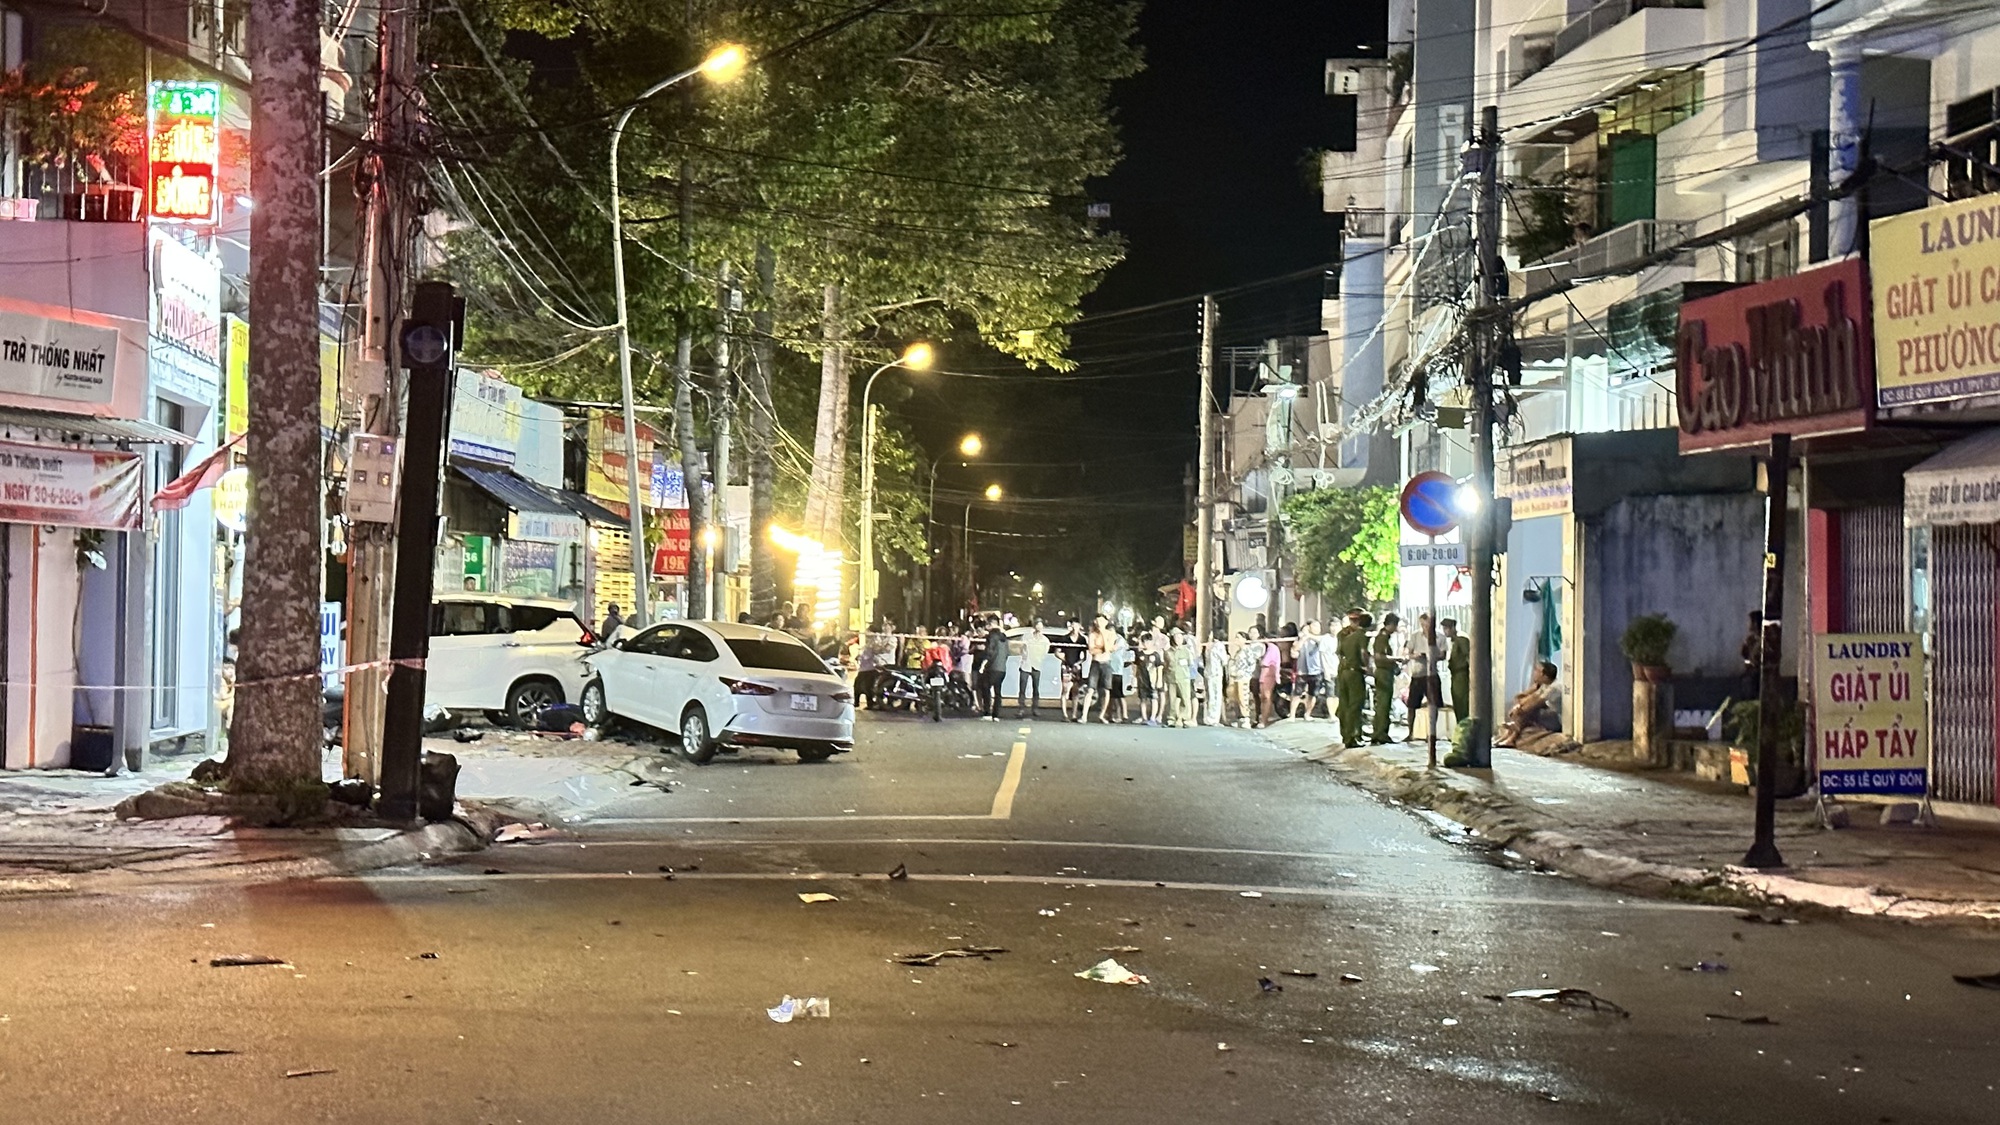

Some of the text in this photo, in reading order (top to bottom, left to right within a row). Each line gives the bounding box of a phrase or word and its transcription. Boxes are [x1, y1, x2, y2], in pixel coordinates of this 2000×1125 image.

[1886, 272, 1938, 326] GIẶT
[1947, 257, 1972, 310] ỦI
[3, 335, 105, 373] TRÀ THỐNG NHẤT
[4, 477, 31, 500] NGÀY
[662, 555, 686, 570] 19K
[1407, 547, 1458, 561] 6:00-20:00
[1828, 642, 1913, 659] LAUNDRY
[1830, 660, 1910, 711] GIẶT ỦI
[1825, 713, 1918, 759] HẤP TẨY
[1843, 773, 1856, 788] 55
[1858, 770, 1870, 787] LÊ
[1899, 770, 1923, 787] ĐÔN
